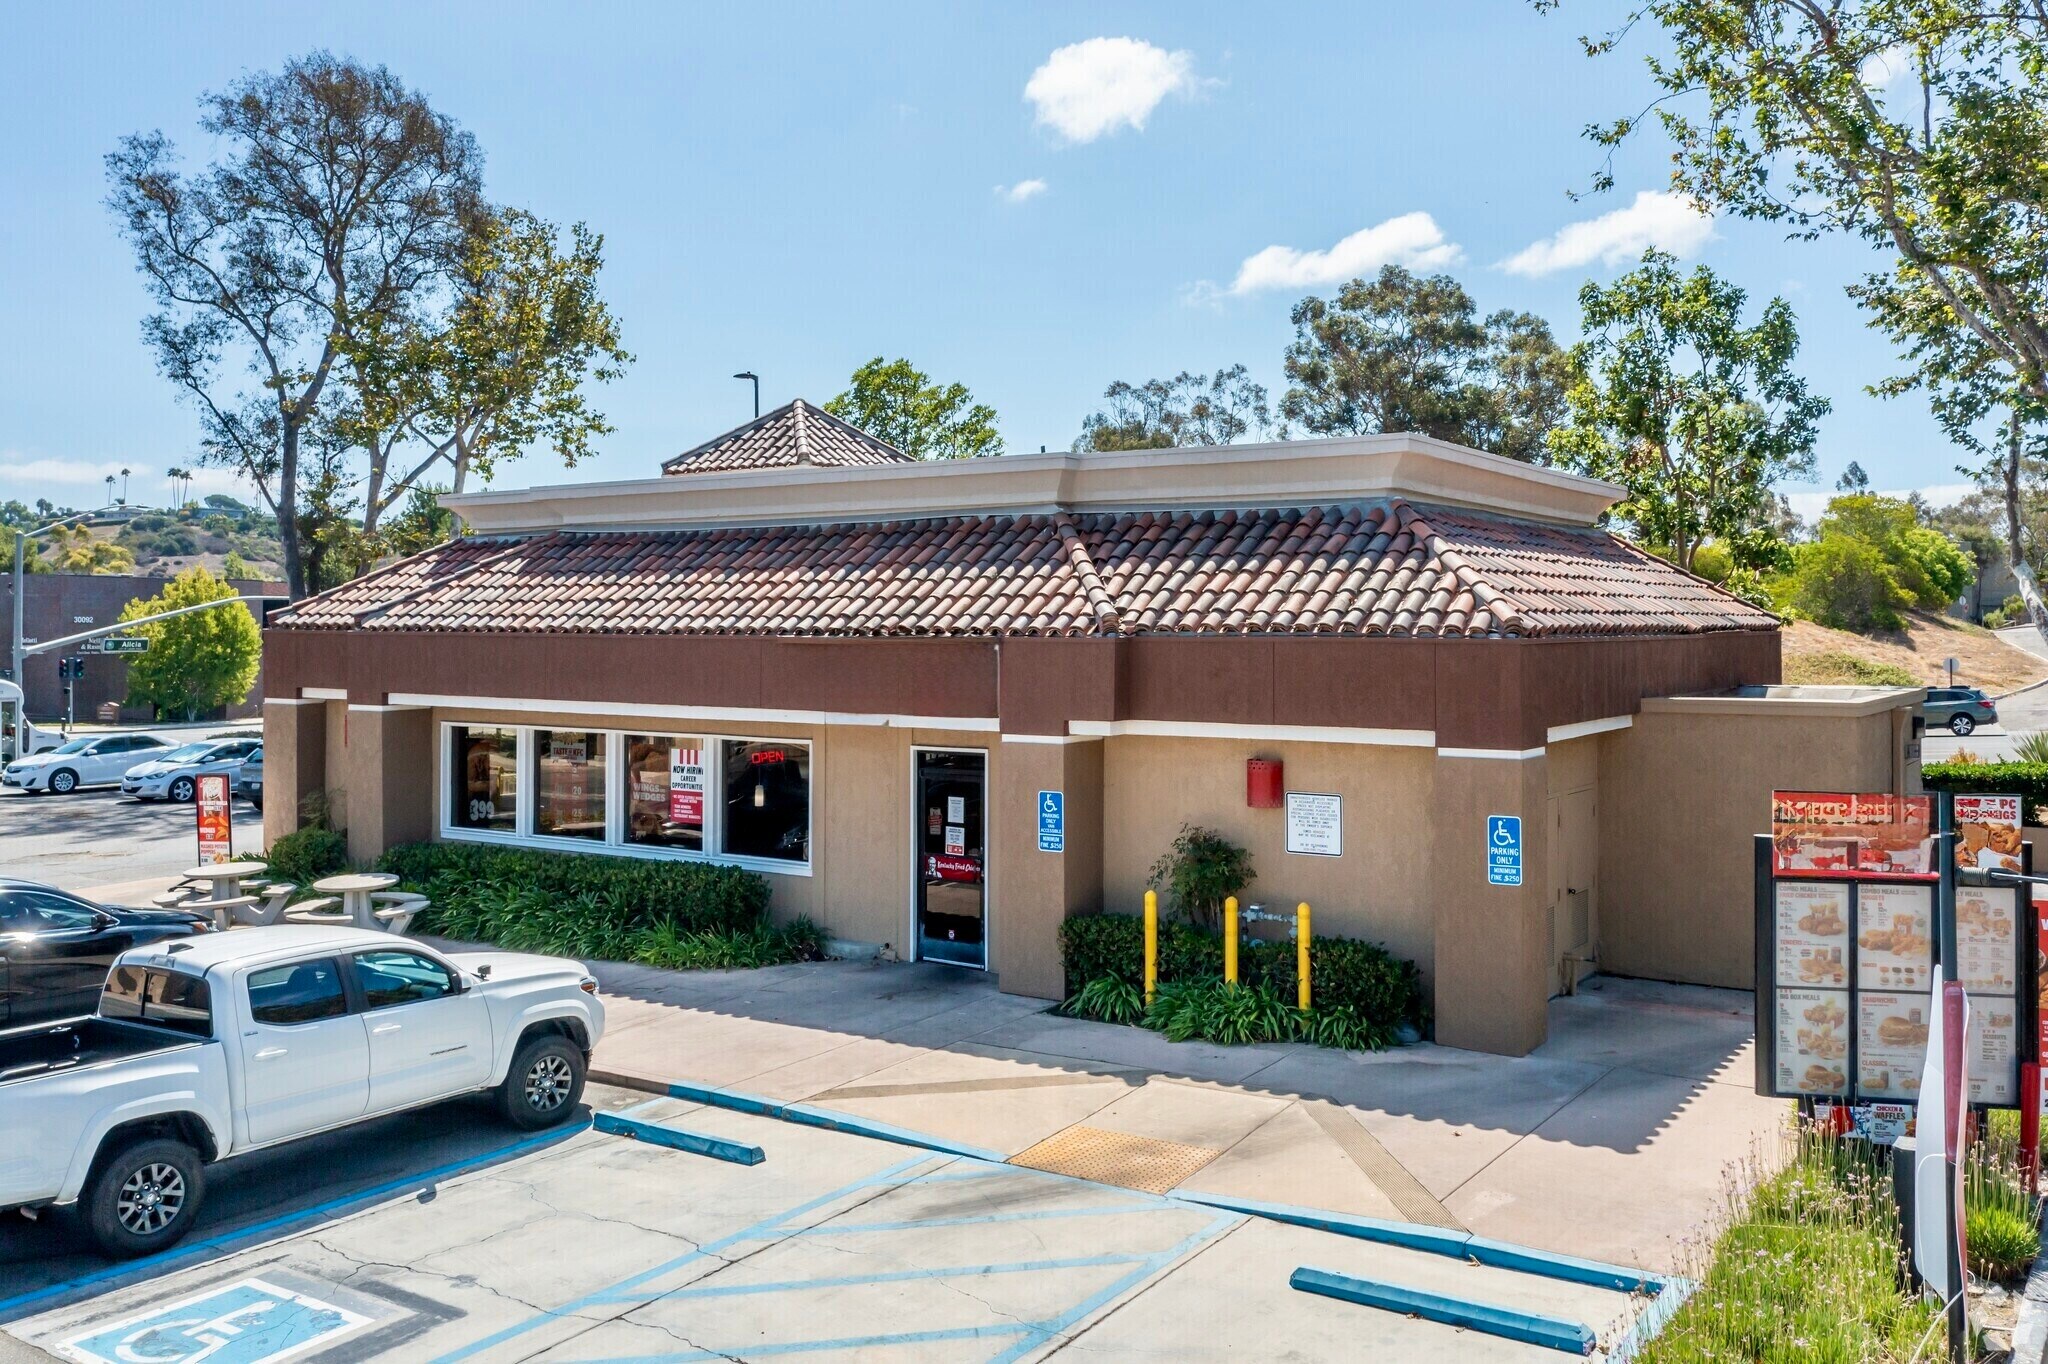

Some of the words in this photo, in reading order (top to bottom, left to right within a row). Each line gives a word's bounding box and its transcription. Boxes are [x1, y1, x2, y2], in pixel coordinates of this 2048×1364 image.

[752, 751, 784, 764] OPEN
[672, 766, 686, 774] NOW
[634, 782, 660, 792] WINGS
[672, 782, 703, 790] OPPORTUNITIE
[1999, 798, 2016, 810] PC
[1490, 846, 1519, 856] PARKING
[1496, 856, 1514, 864] ONLY
[937, 861, 954, 870] Kentucky
[954, 862, 965, 870] Fried
